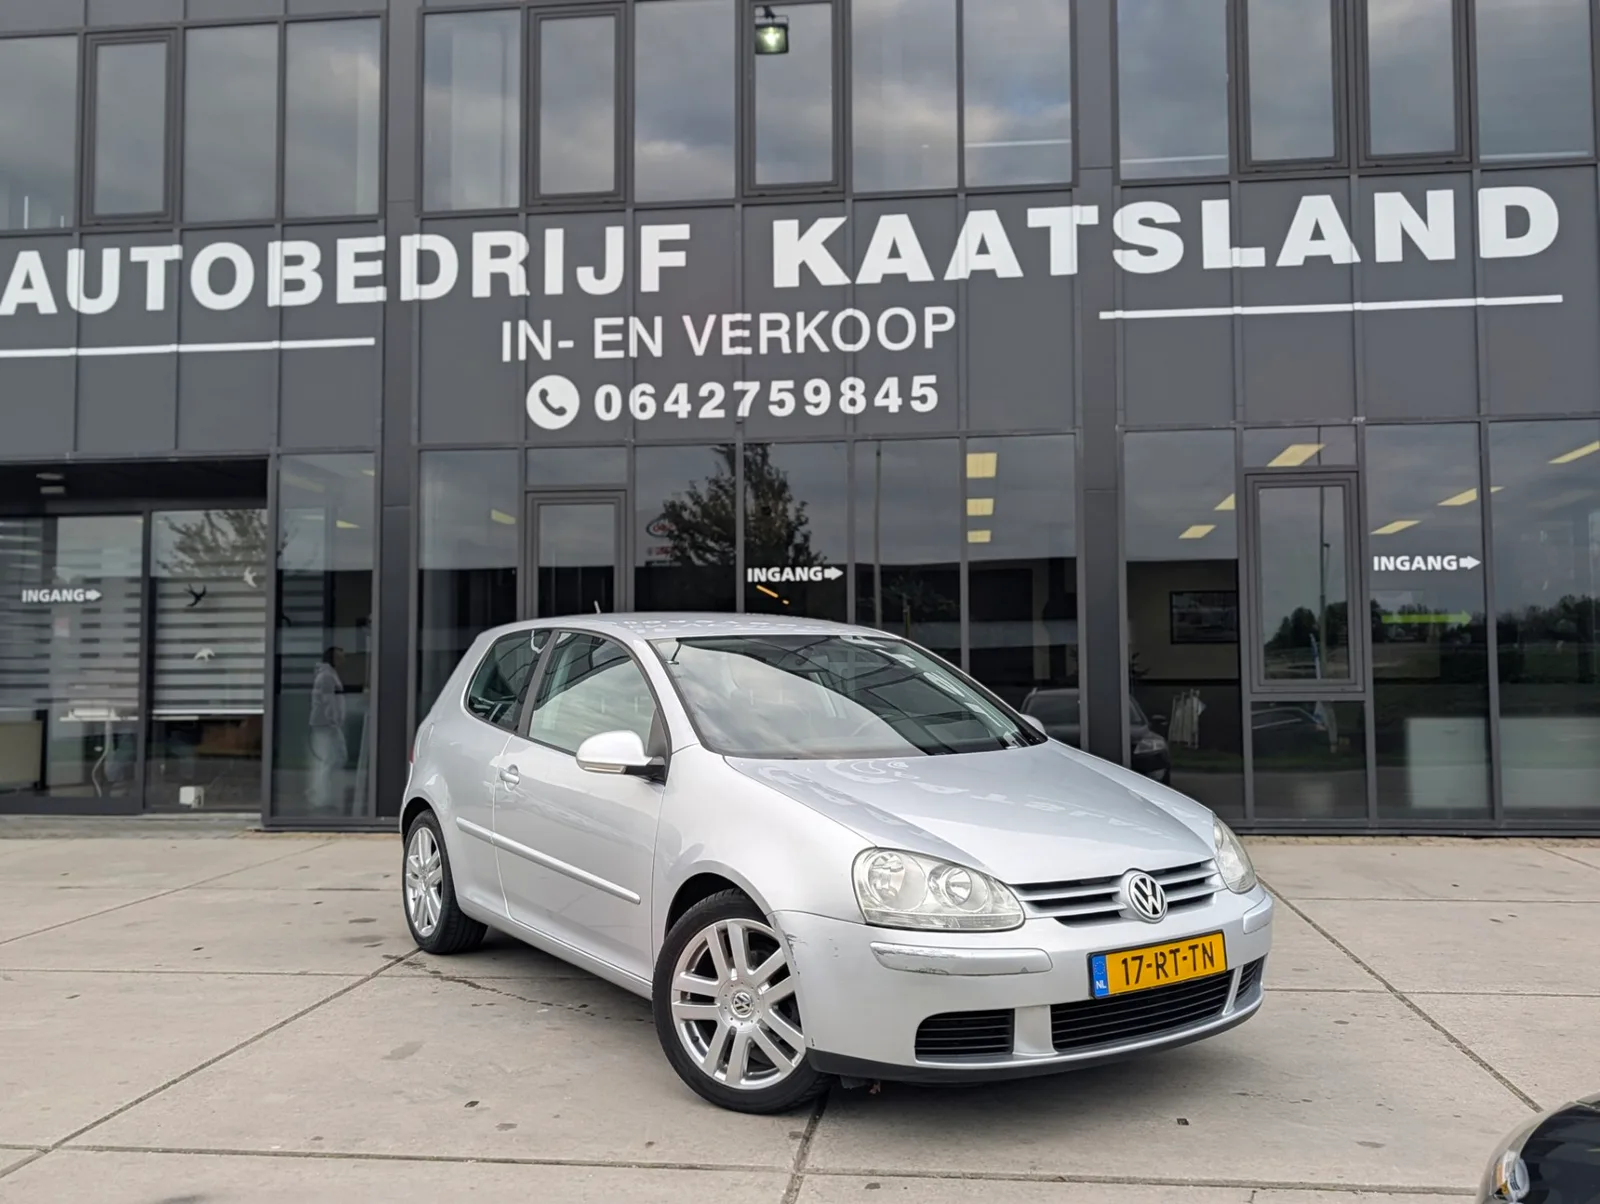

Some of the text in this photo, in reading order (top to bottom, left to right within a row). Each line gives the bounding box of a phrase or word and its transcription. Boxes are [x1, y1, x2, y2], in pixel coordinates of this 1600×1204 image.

[0, 186, 1559, 316] AUTOBEDRIJF KAATSLAND
[502, 306, 956, 362] IN- EN VERKOOP
[594, 374, 939, 421] 0642759845
[747, 566, 823, 582] INGANG
[1373, 554, 1458, 571] INGANG
[22, 588, 85, 602] INGANG
[1121, 940, 1216, 986] 17-RT-TN
[1095, 979, 1107, 989] NL
